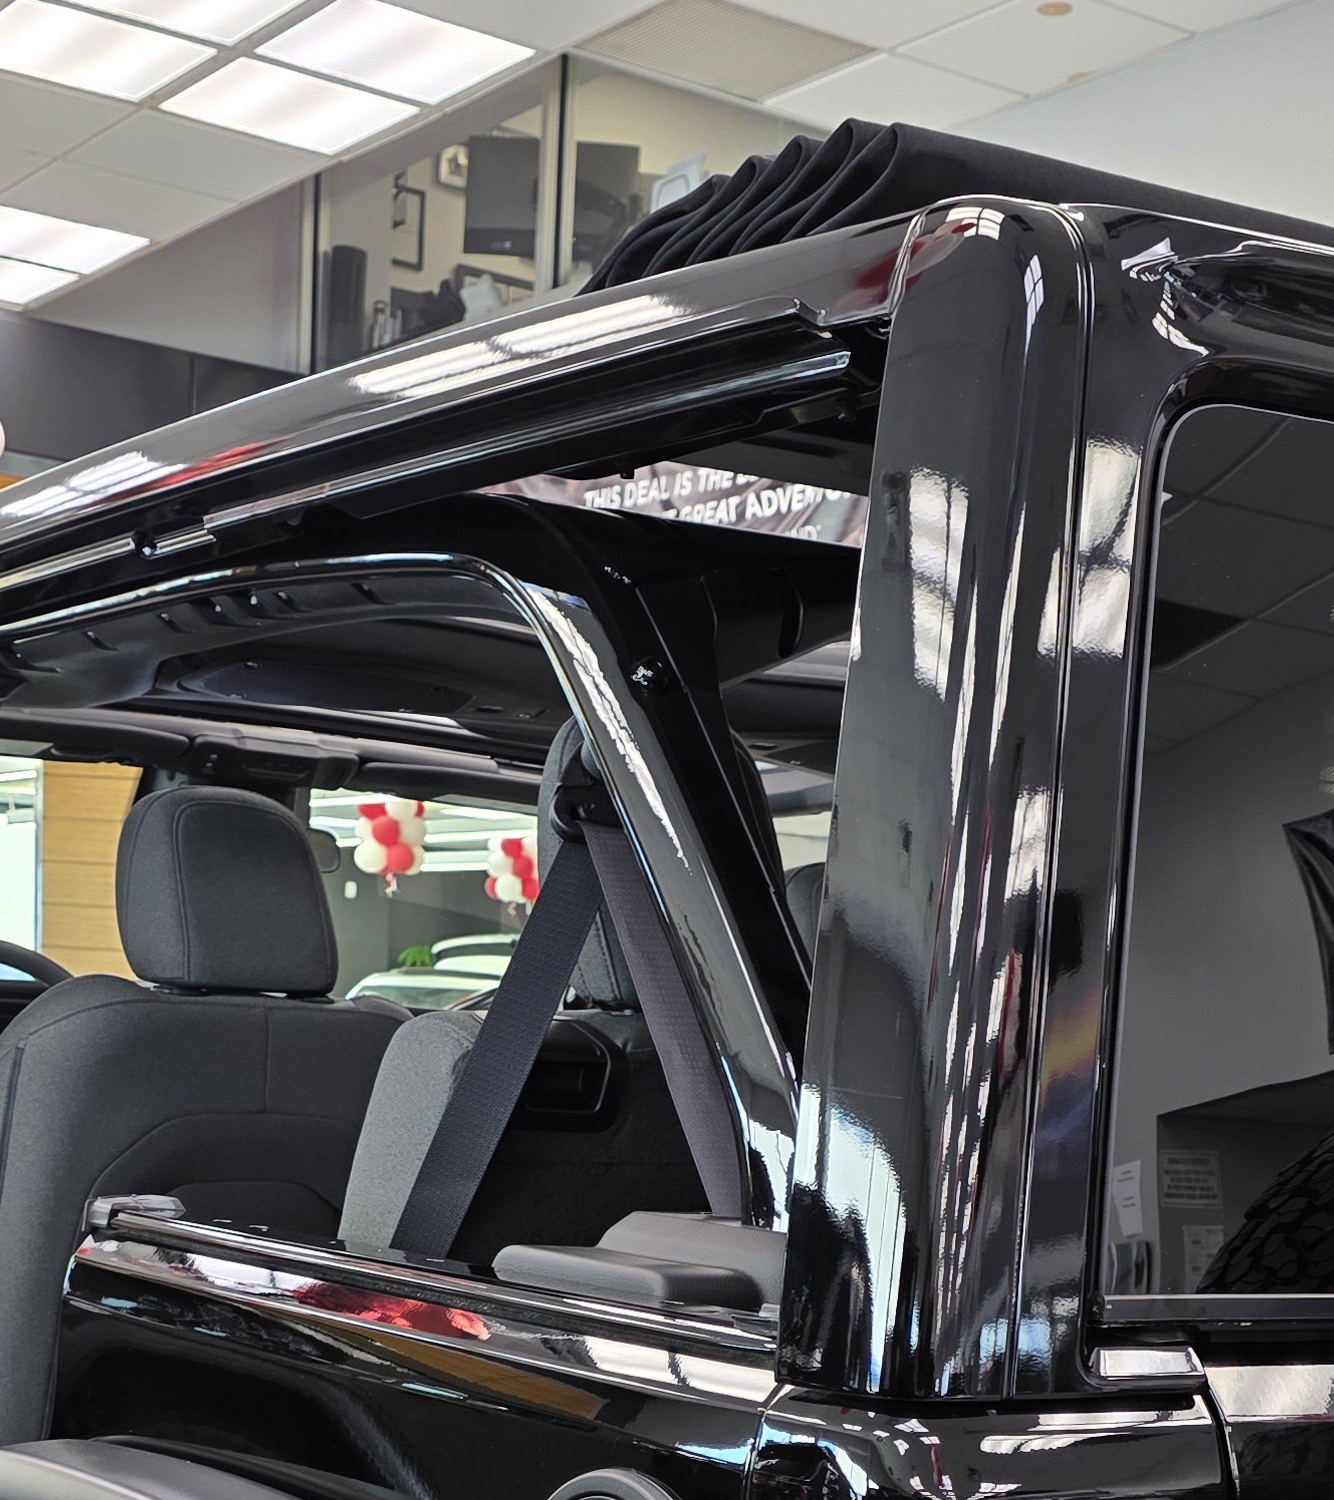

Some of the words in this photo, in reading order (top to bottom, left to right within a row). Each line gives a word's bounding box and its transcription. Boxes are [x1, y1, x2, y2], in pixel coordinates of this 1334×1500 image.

[583, 483, 621, 509] THIS
[624, 475, 670, 508] DEAL
[673, 470, 693, 497] IS
[697, 467, 734, 493] THE
